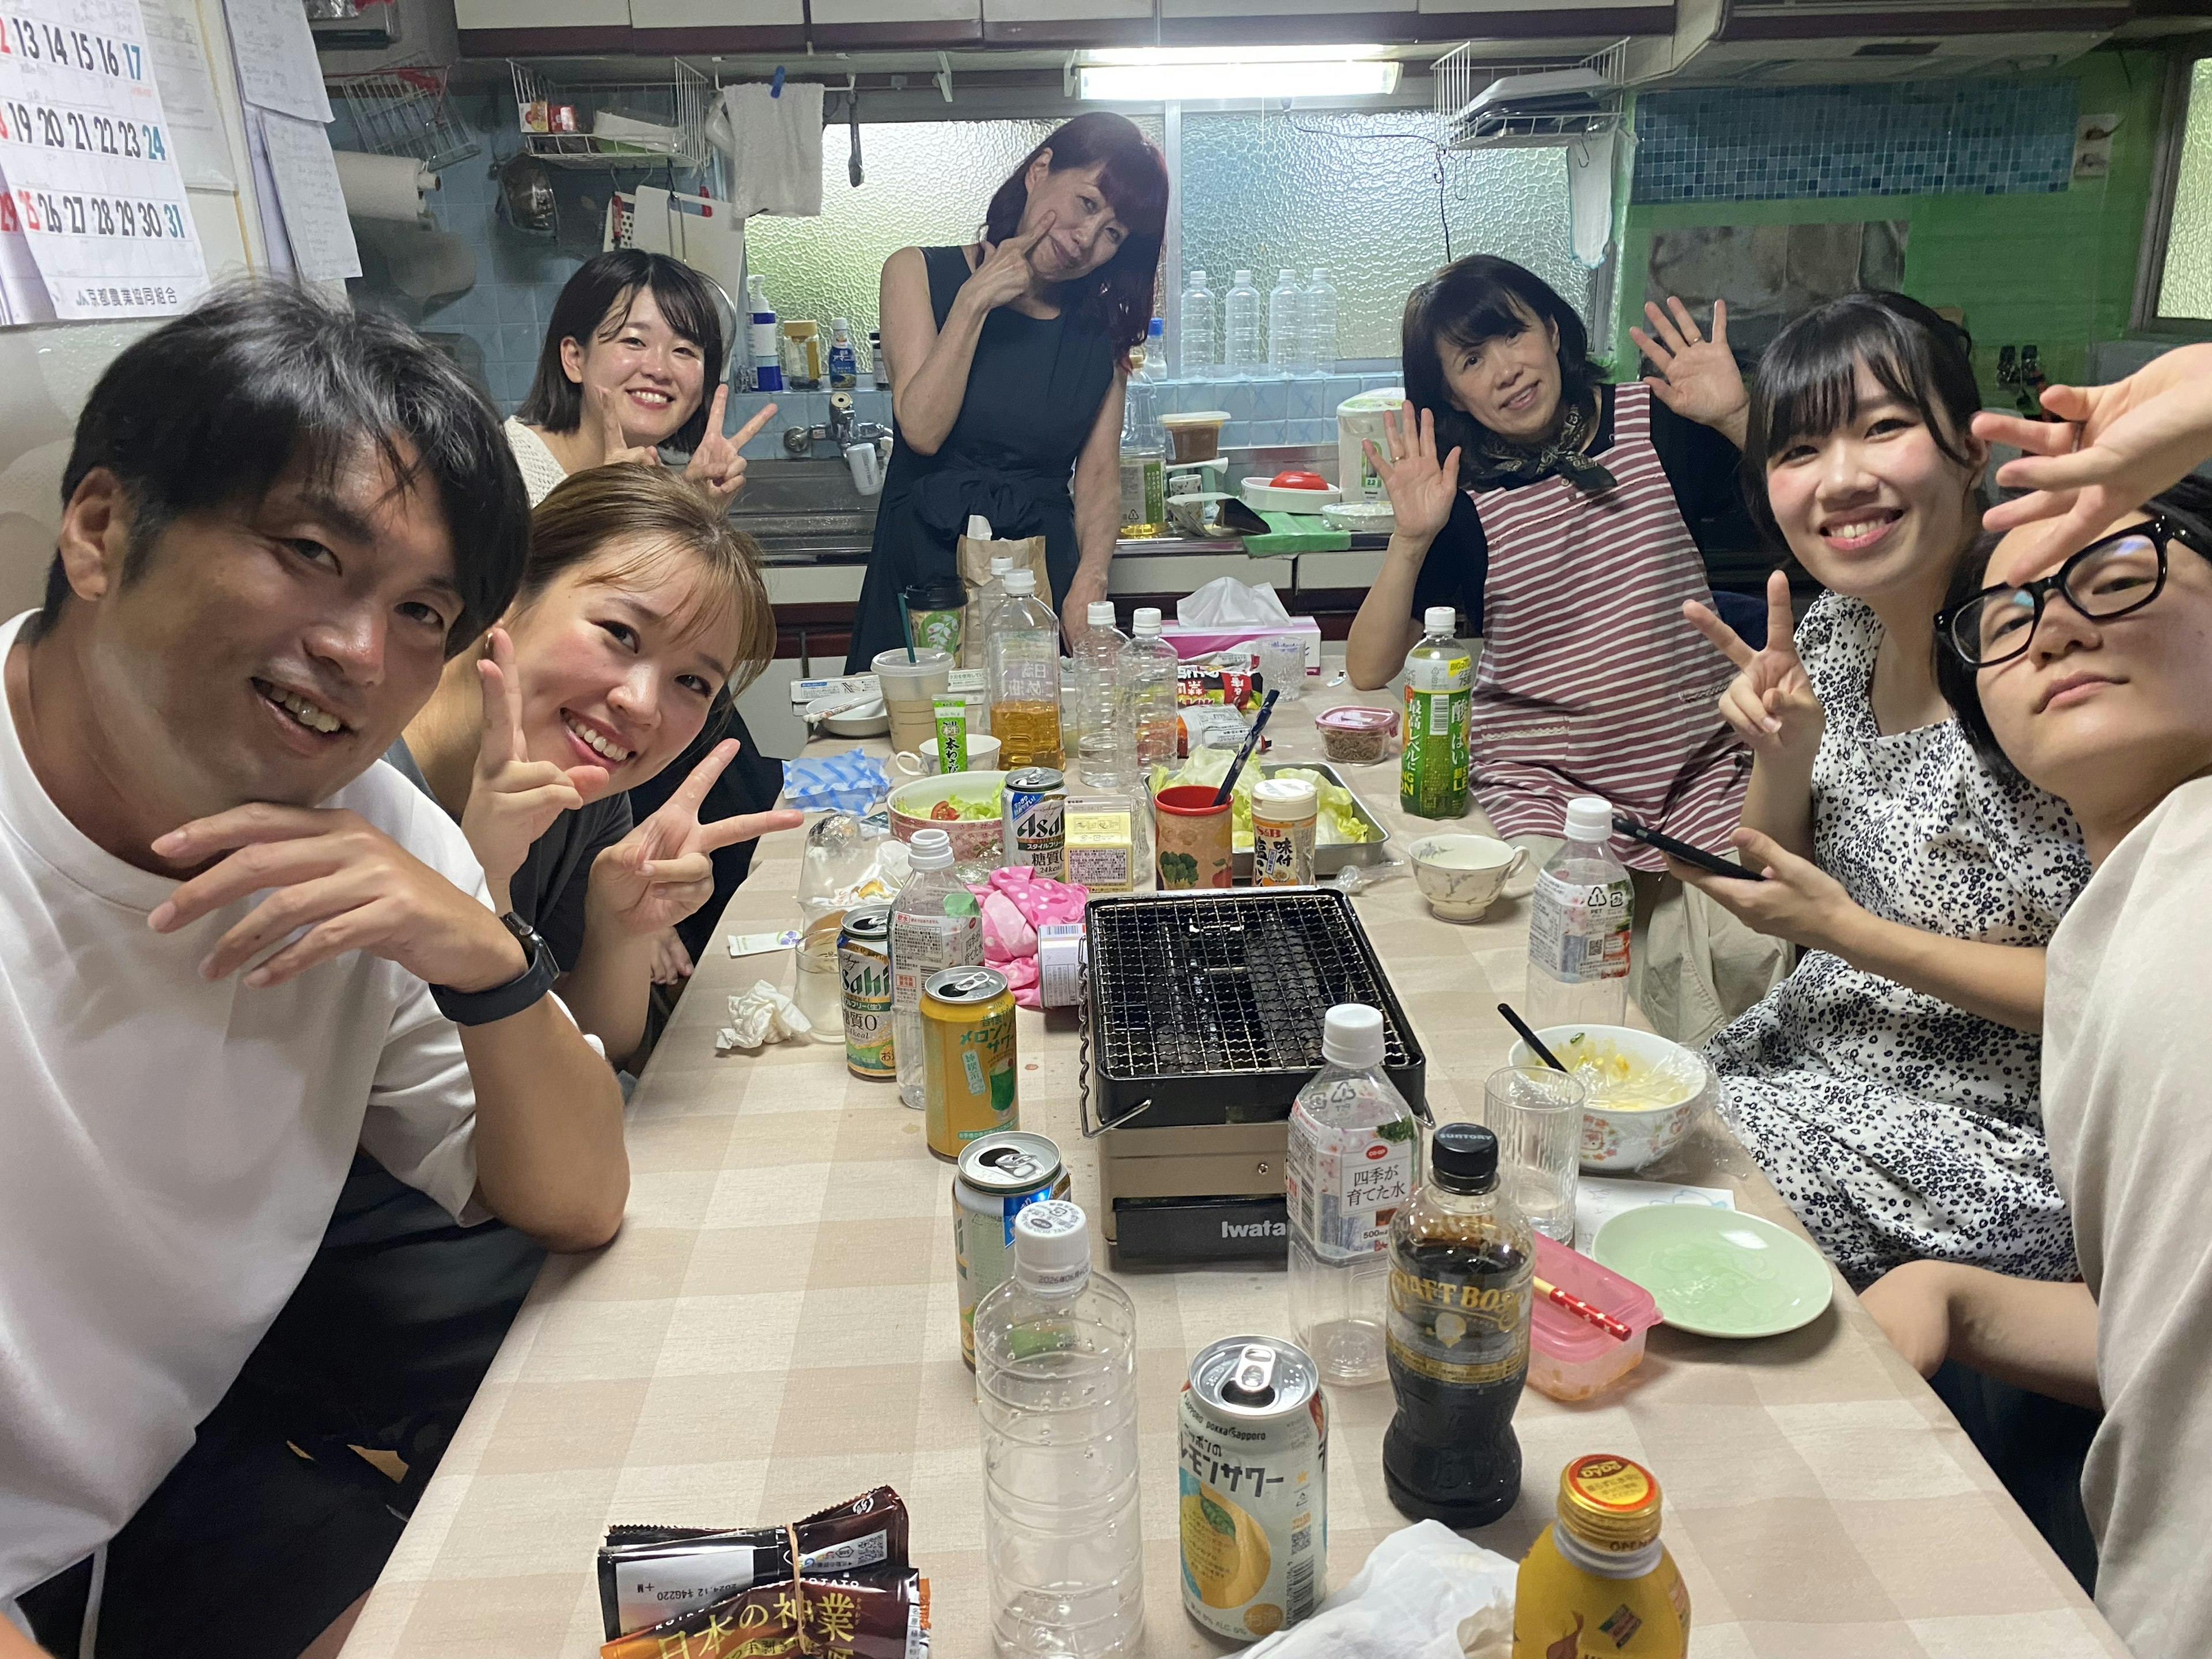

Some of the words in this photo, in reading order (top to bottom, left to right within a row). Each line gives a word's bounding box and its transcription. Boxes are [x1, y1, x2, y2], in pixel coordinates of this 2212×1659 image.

[12, 17, 40, 59] 13
[42, 24, 68, 65] 14
[70, 31, 94, 71] 15
[96, 37, 119, 77] 16
[122, 43, 141, 80] 17
[7, 101, 32, 143] 19
[37, 107, 65, 148] 20
[67, 112, 93, 151] 21
[93, 116, 119, 154] 22
[118, 120, 141, 158] 23
[142, 124, 166, 161] 24
[37, 193, 62, 233] 26
[63, 196, 86, 233] 27
[91, 197, 115, 235] 28
[116, 199, 135, 236] 29
[138, 202, 162, 237] 30
[164, 204, 185, 238] 31
[1256, 825, 1281, 838] S&B
[1440, 1132, 1493, 1141] SUNTORY
[1354, 1164, 1399, 1187] 四季が
[1347, 1181, 1407, 1207] 育てた水
[1221, 1219, 1287, 1238] Iwata
[1389, 1269, 1457, 1312] CRAFT
[1460, 1285, 1527, 1331] BOSS
[1181, 1433, 1284, 1498] レモンサワー
